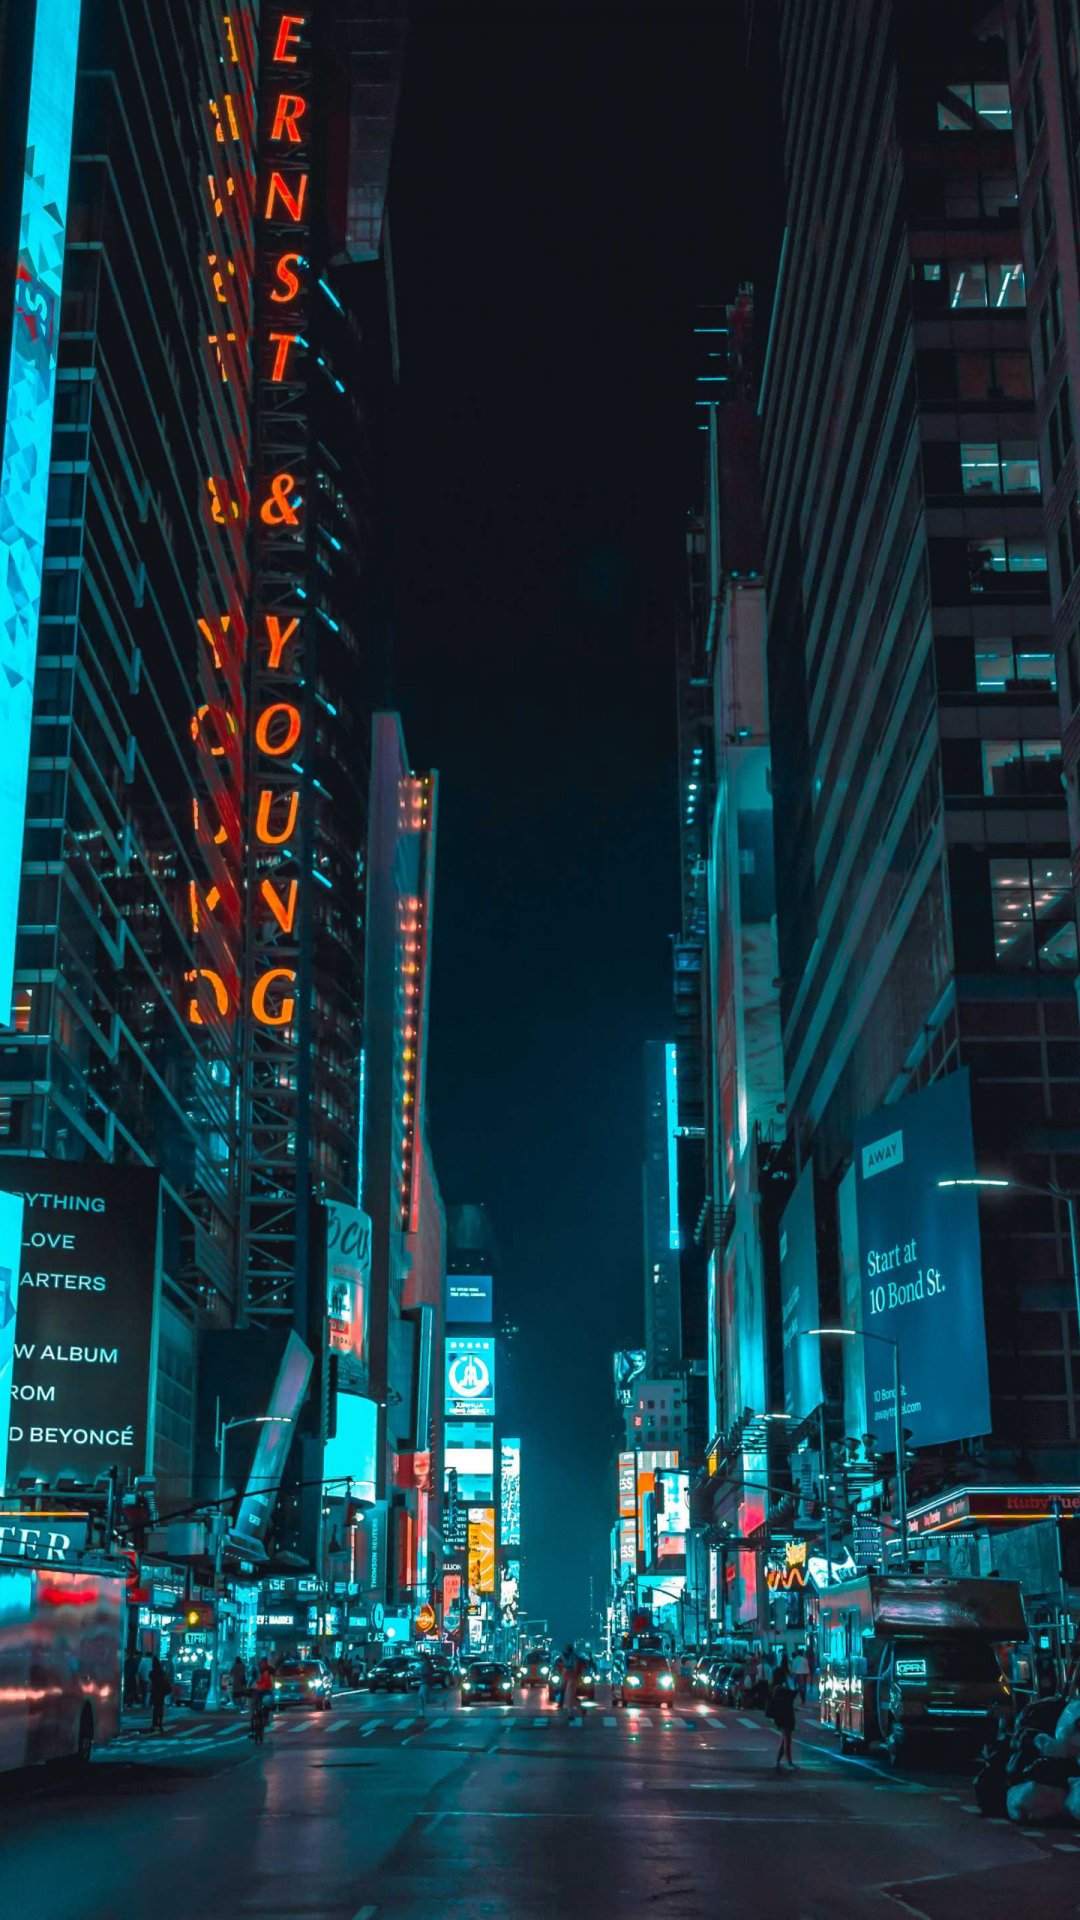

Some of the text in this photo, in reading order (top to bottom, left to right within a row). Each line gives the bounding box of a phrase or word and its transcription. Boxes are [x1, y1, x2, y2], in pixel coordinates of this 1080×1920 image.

[265, 16, 306, 382] ERNST
[260, 473, 300, 525] &
[867, 1143, 897, 1168] AWAY
[12, 1191, 106, 1213] YTHING
[867, 1238, 918, 1277] Start at
[20, 1272, 106, 1291] ARTERS
[869, 1268, 946, 1315] 10 Bond St.
[14, 1344, 118, 1363] W ALBUM
[874, 1402, 921, 1421] awaytrel.com
[9, 1425, 134, 1446] D BEYONCÉ
[1007, 1496, 1049, 1511] Ruby
[367, 1632, 385, 1642] CASE
